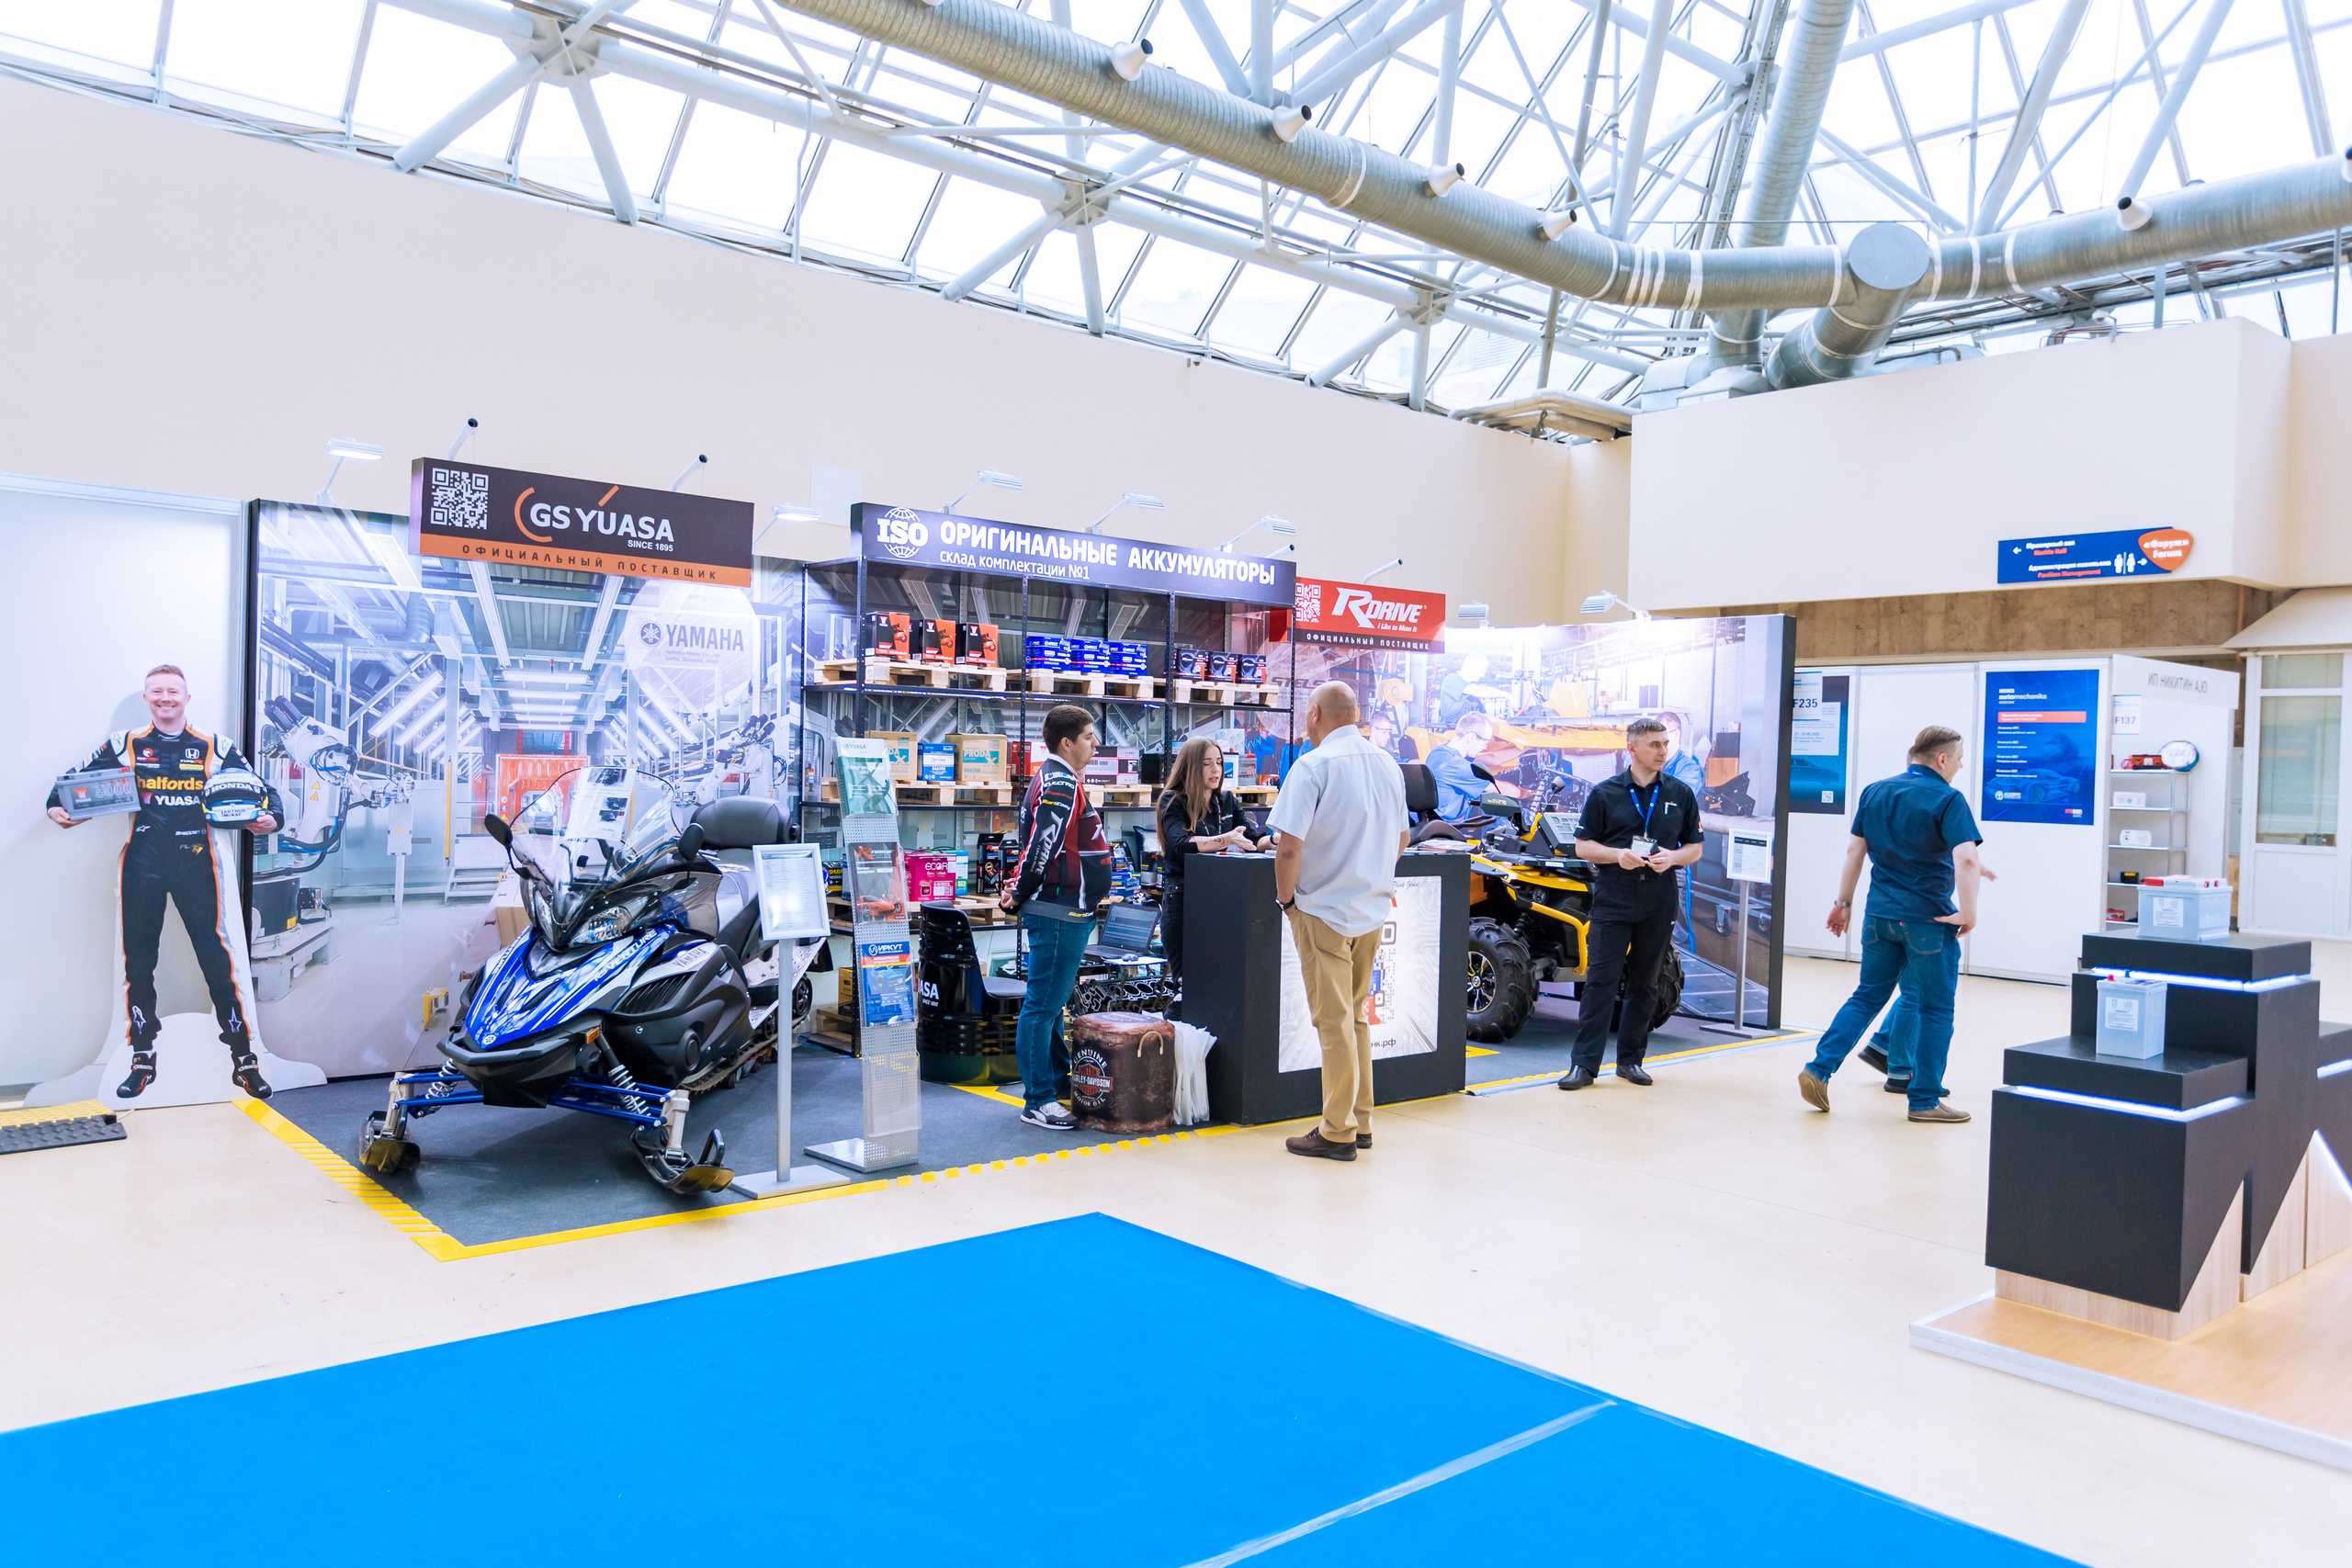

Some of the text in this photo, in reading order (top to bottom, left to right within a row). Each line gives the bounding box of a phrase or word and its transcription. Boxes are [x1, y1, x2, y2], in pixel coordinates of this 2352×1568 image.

[530, 502, 675, 542] GS YUASA
[876, 517, 929, 547] ISO
[628, 539, 673, 552] SINCE 1895
[940, 520, 1275, 585] ОРИГИНАЛЬНЫЕ АККУМУЛЯТОРЫ
[2153, 549, 2182, 558] Forum
[462, 545, 717, 580] ОФИЦИАЛЬНЫЙ ПОСТАВЩИК
[940, 550, 1091, 581] склад комплектации №1
[665, 624, 744, 651] YAMAHA
[1306, 633, 1430, 650] ОФИЦИАЛЬНЫЙ ПОСТАВЩИК
[2148, 672, 2158, 686] ИП
[2160, 674, 2193, 691] НИКИТИН
[1792, 698, 1818, 708] F235
[95, 781, 132, 798] 5000
[136, 774, 204, 792] halfords
[210, 783, 254, 795] HONDA
[154, 794, 201, 807] YUASA
[878, 943, 902, 952] ИРКУТ
[672, 947, 711, 968] YAMAHA
[1370, 1037, 1396, 1048] нк.рф
[1073, 1048, 1108, 1069] GENUINE
